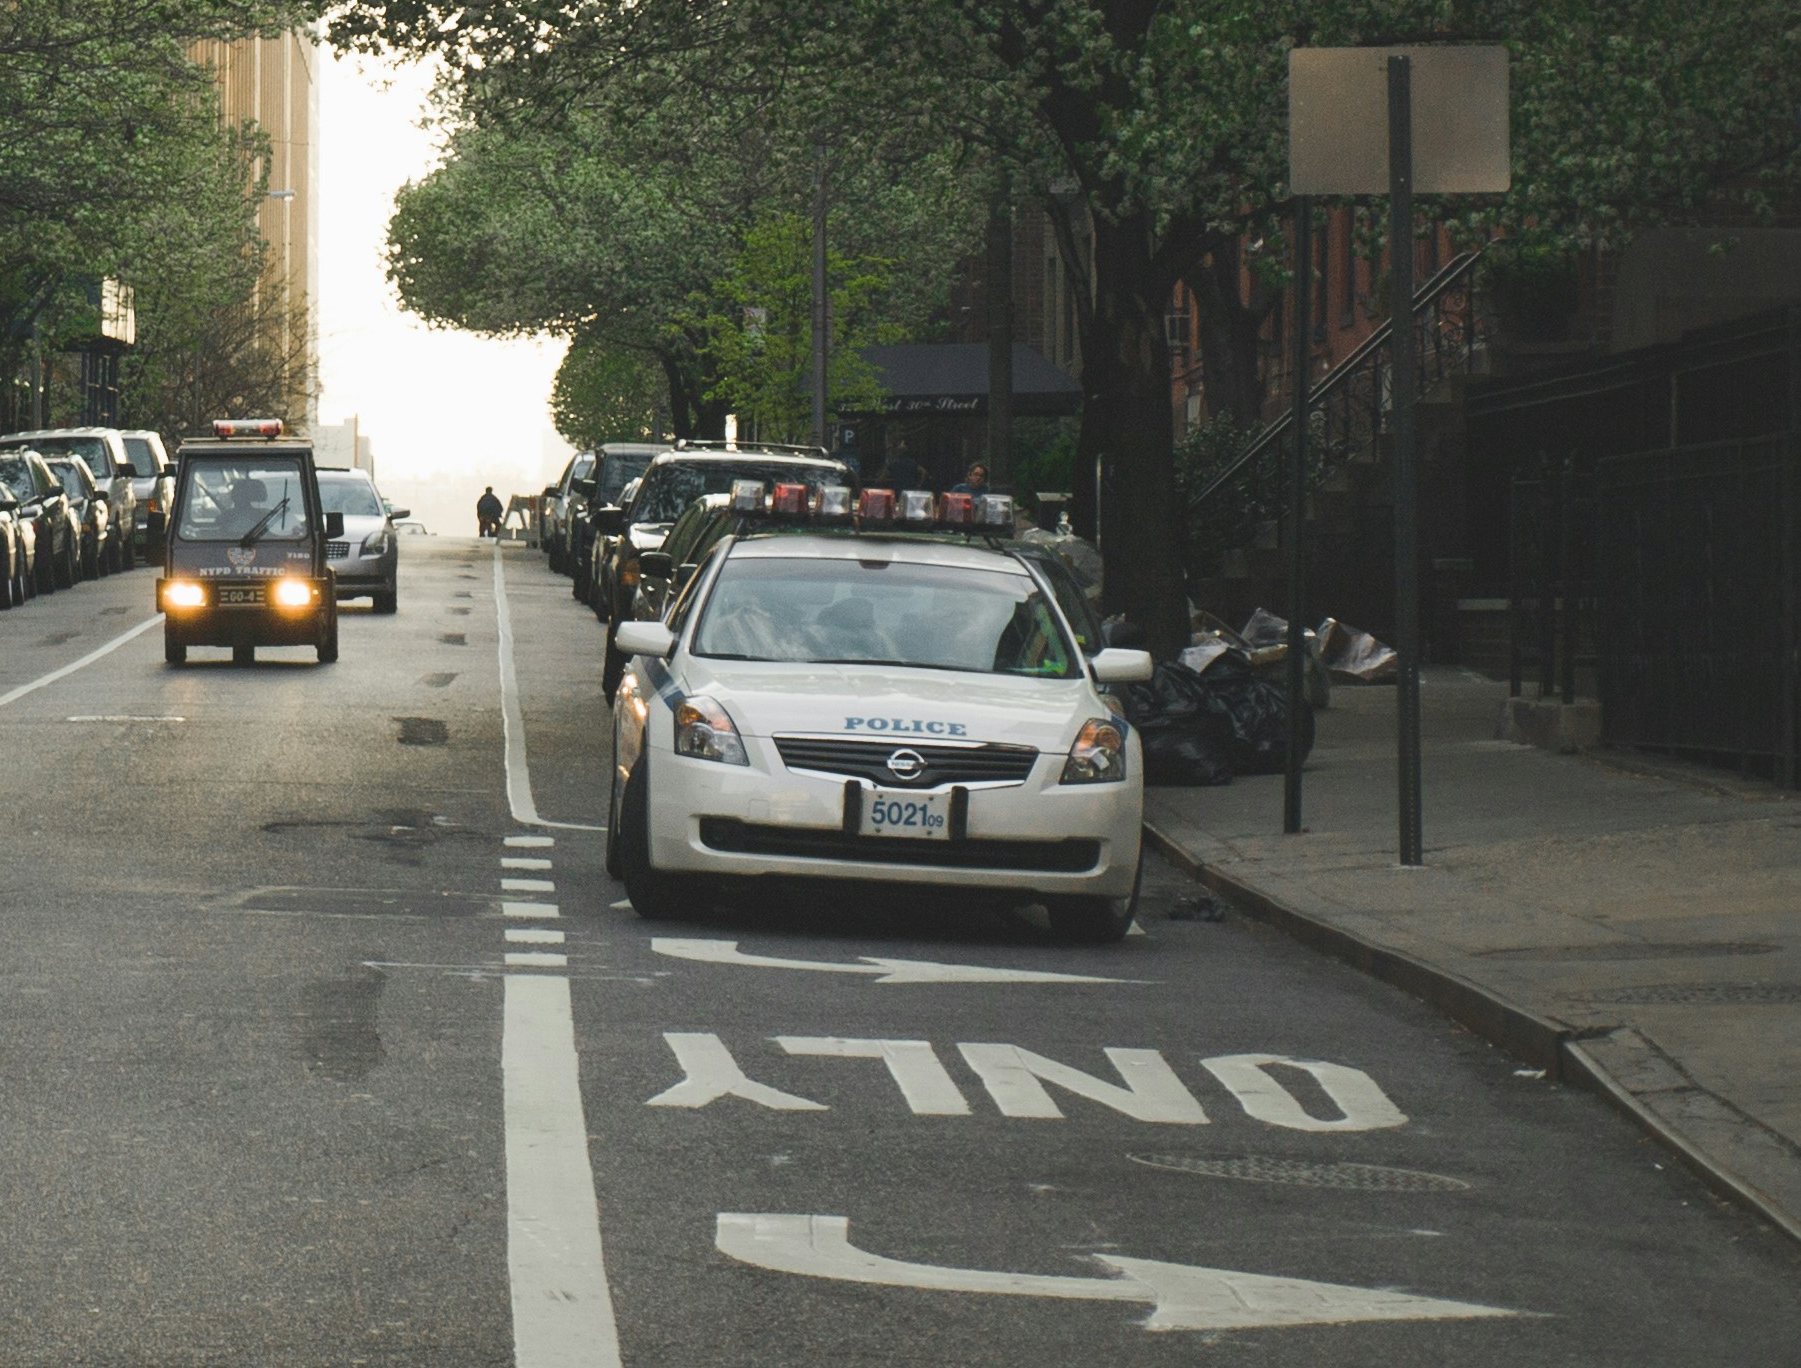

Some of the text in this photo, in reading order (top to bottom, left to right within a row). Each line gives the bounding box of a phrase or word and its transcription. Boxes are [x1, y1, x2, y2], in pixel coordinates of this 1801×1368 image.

[936, 396, 979, 410] Street
[200, 566, 285, 576] NYPD TRAFFIC
[844, 716, 967, 737] POLICE
[871, 800, 928, 827] 5021
[645, 1032, 1409, 1132] ONLY
